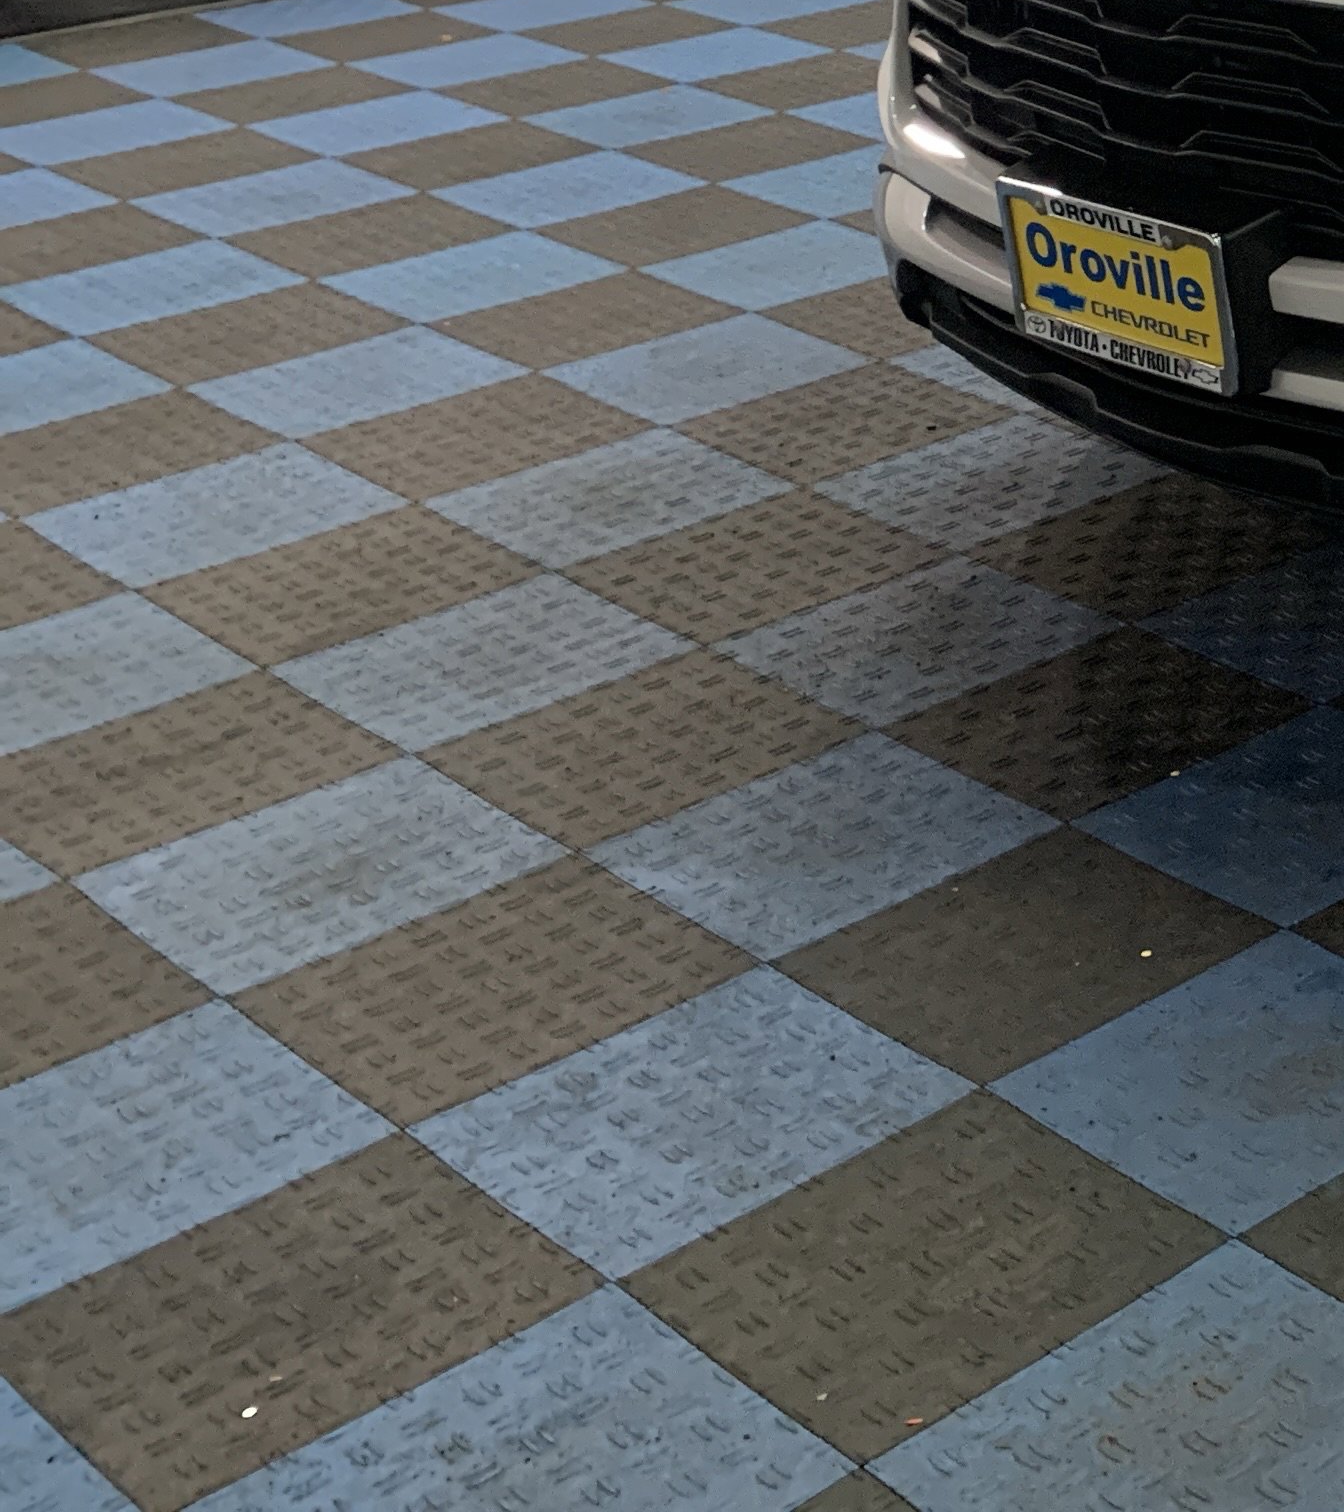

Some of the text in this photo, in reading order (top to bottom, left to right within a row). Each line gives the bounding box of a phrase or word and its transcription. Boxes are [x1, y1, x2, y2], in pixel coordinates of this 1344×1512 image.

[1050, 199, 1157, 242] OROVILLE
[1026, 222, 1206, 312] Oroville
[1091, 301, 1210, 348] CHEVROLET
